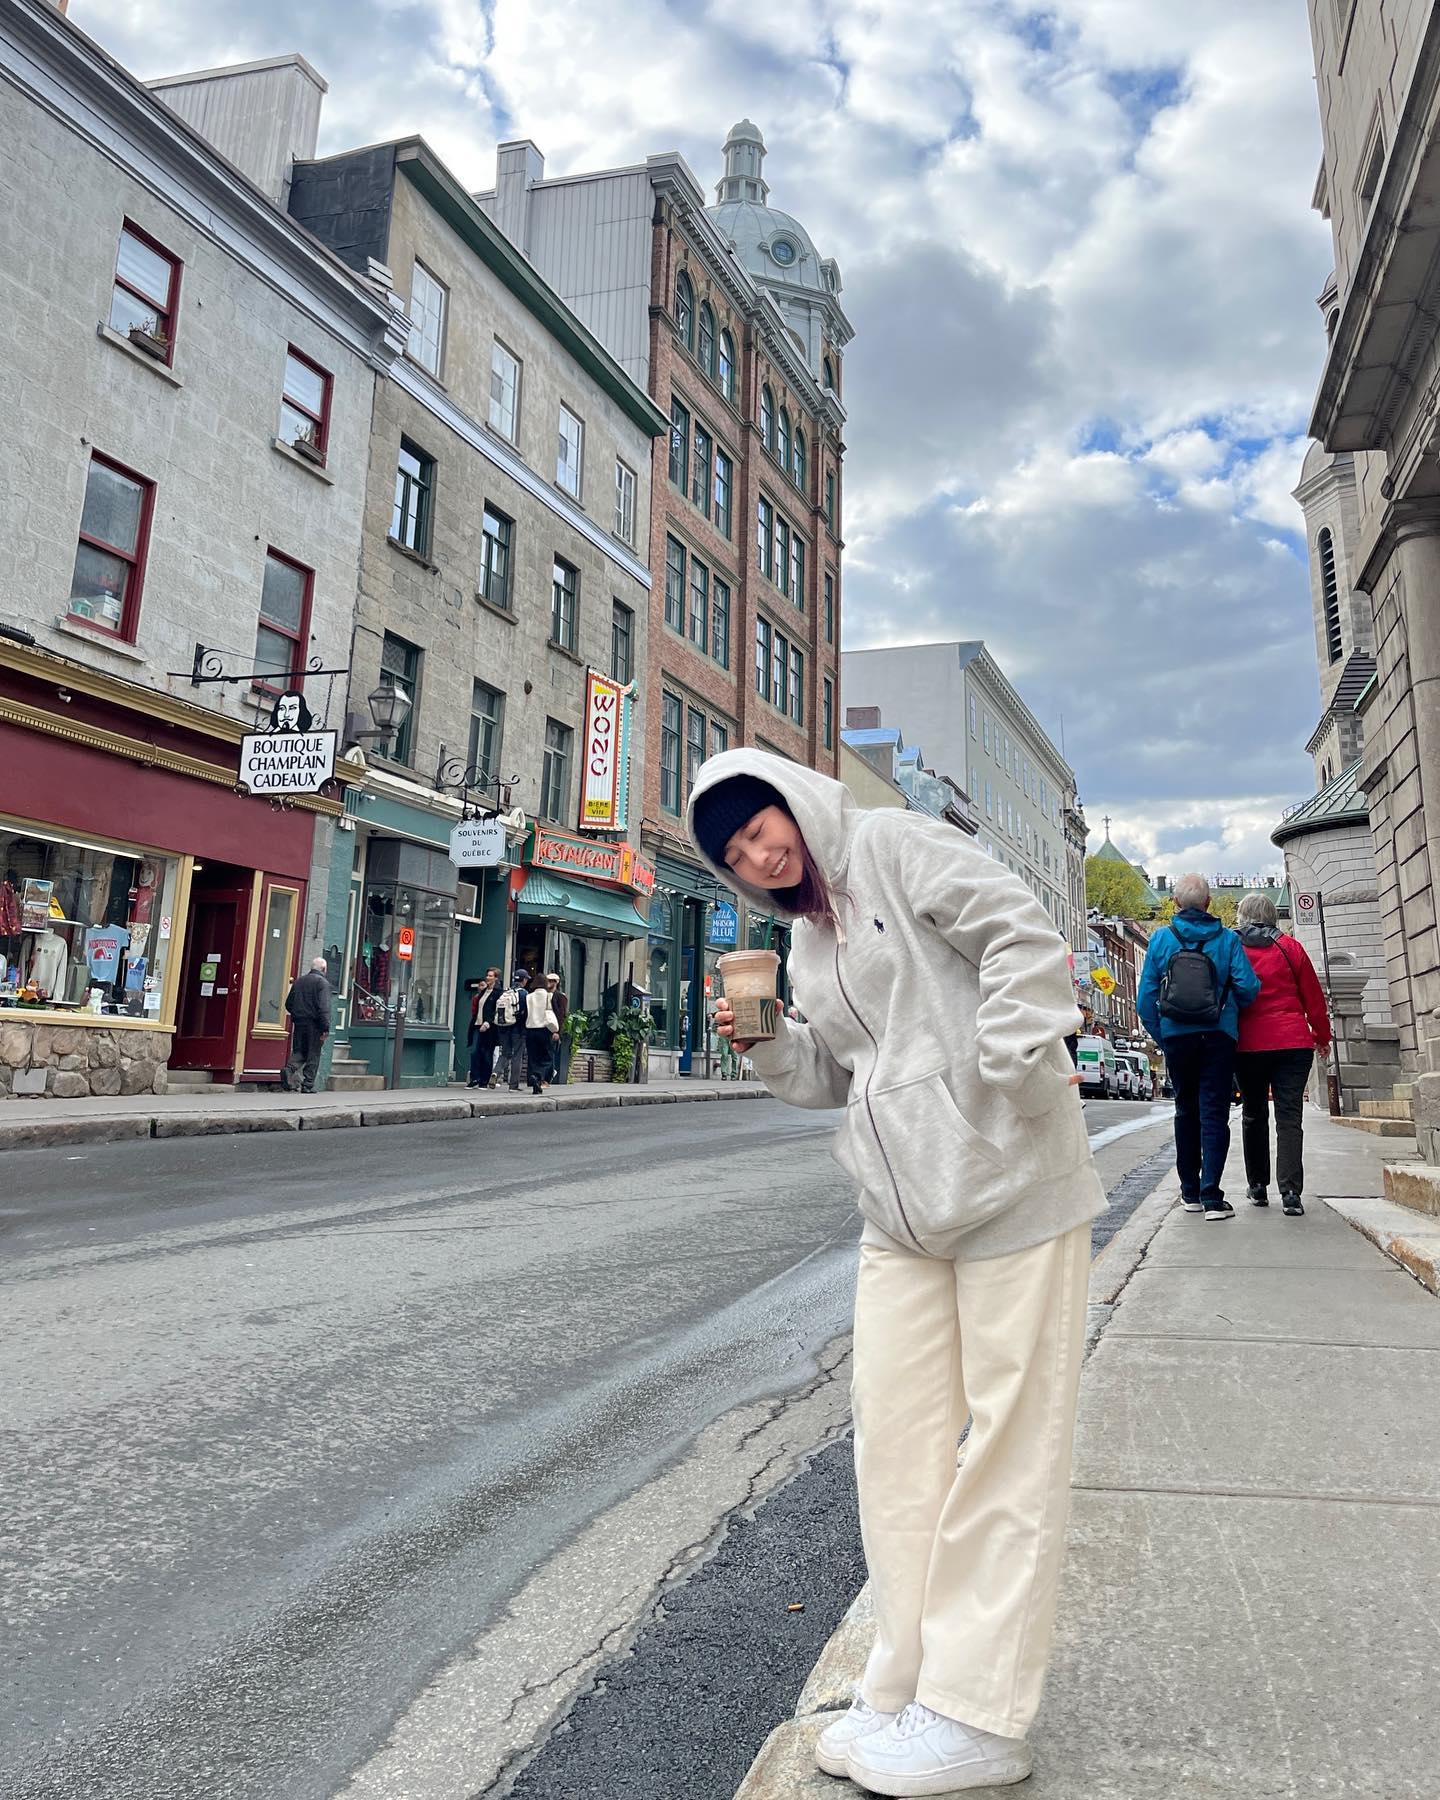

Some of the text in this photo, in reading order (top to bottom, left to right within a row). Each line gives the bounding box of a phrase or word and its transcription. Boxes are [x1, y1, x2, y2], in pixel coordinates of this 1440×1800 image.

[590, 695, 615, 776] WONG
[253, 738, 323, 755] BOUTIQUE
[248, 755, 326, 771] CHAMPLAIN
[253, 772, 317, 788] CADEAUX
[457, 829, 498, 838] SOUVENIRS
[462, 848, 491, 857] QUÉBEC
[540, 839, 619, 871] RESTAURANT
[712, 919, 735, 928] MAISON
[711, 927, 735, 937] BLEUE
